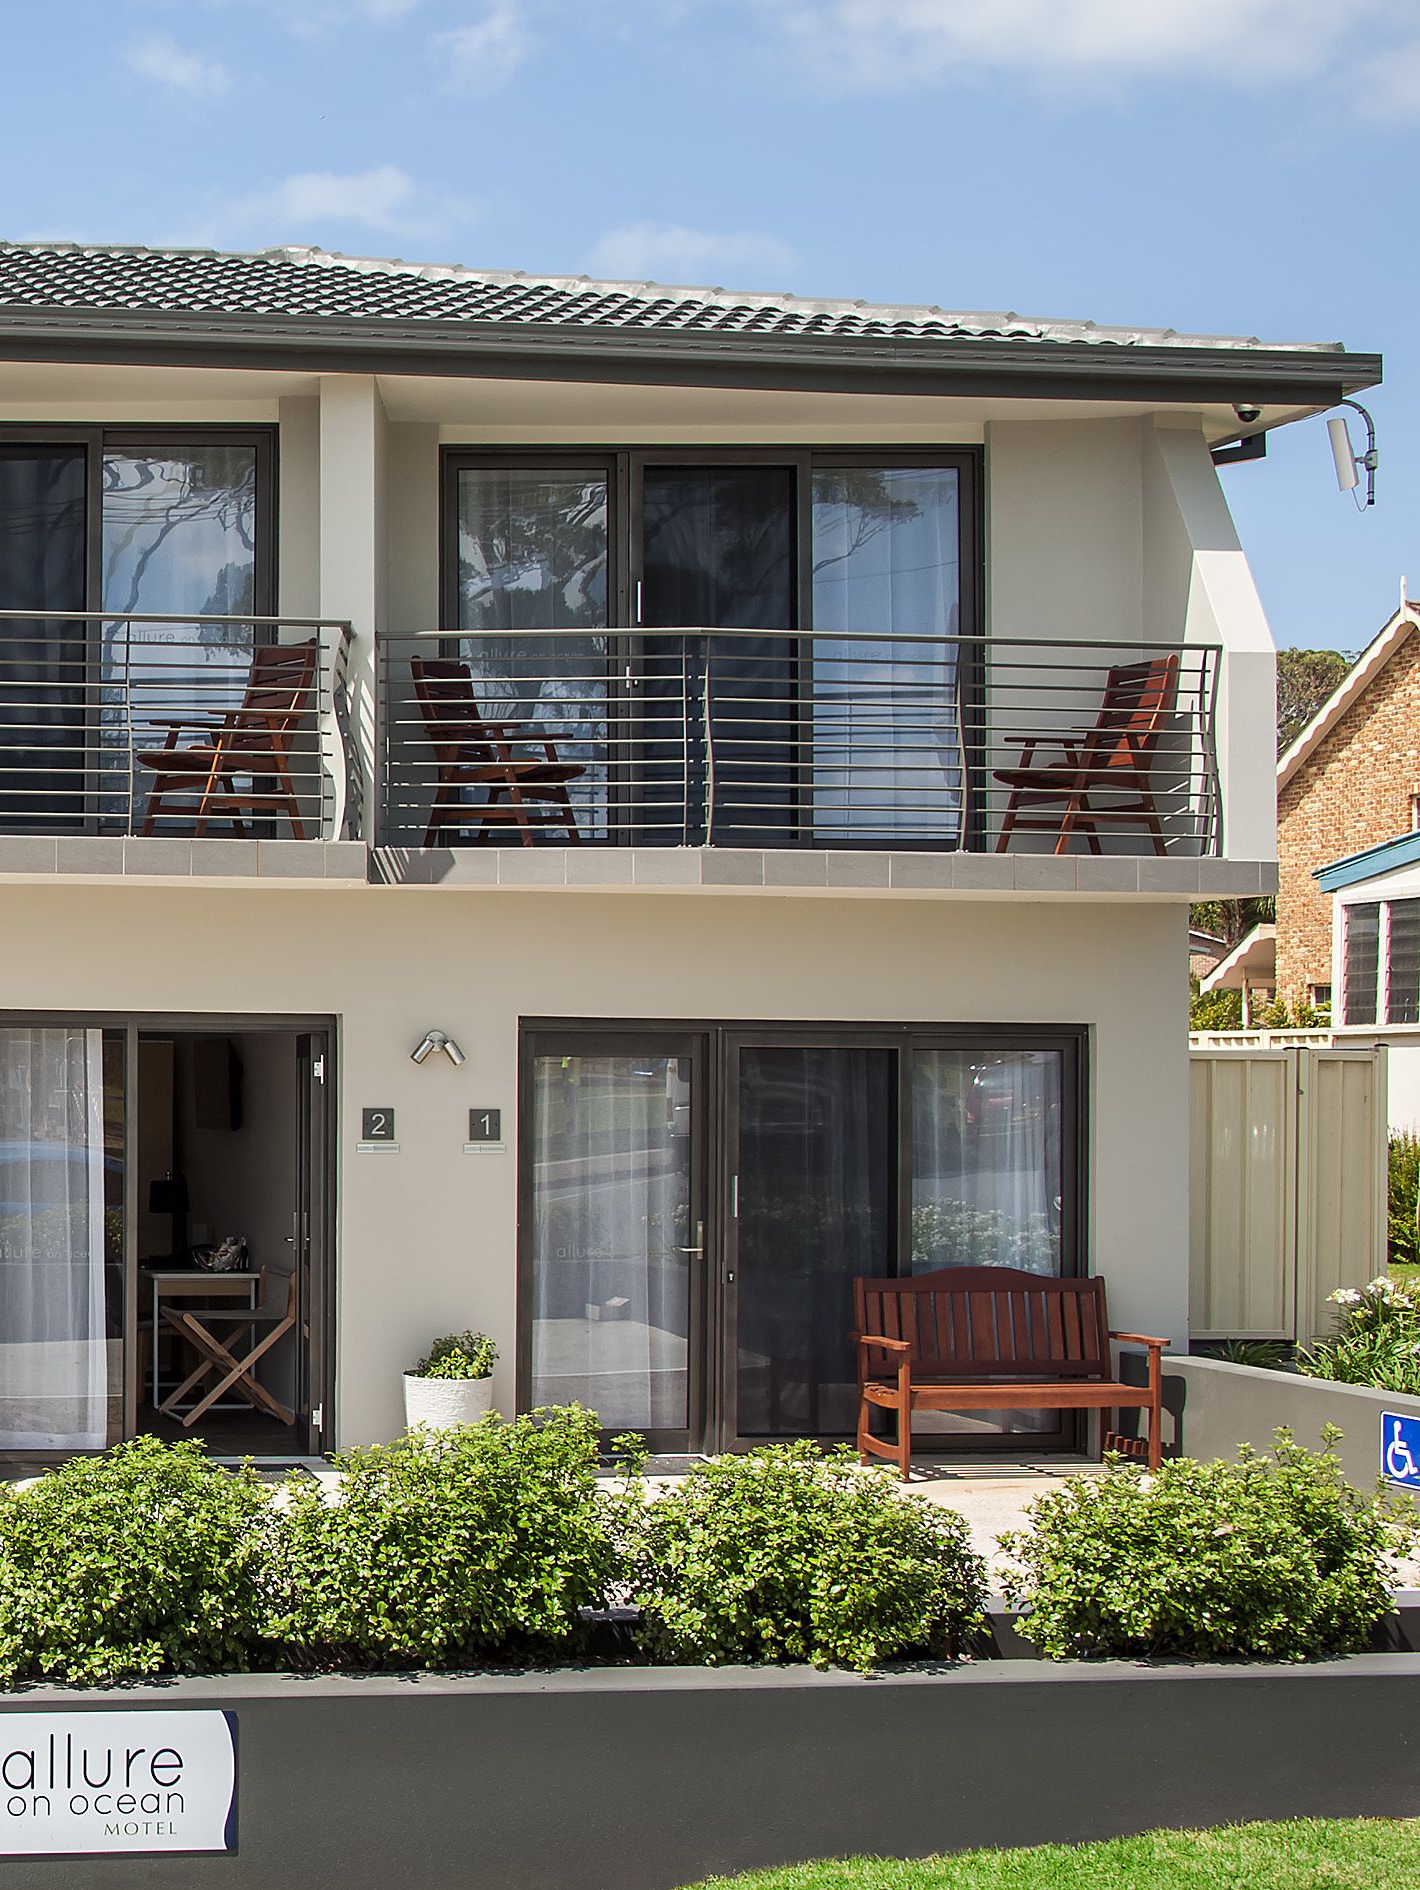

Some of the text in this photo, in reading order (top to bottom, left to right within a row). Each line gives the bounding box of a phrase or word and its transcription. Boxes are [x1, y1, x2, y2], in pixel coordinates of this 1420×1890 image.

[371, 1114, 386, 1135] 2
[480, 1114, 490, 1135] 1
[2, 1733, 184, 1790] allure
[7, 1792, 184, 1816] on ocean
[104, 1821, 178, 1836] MOTEL
